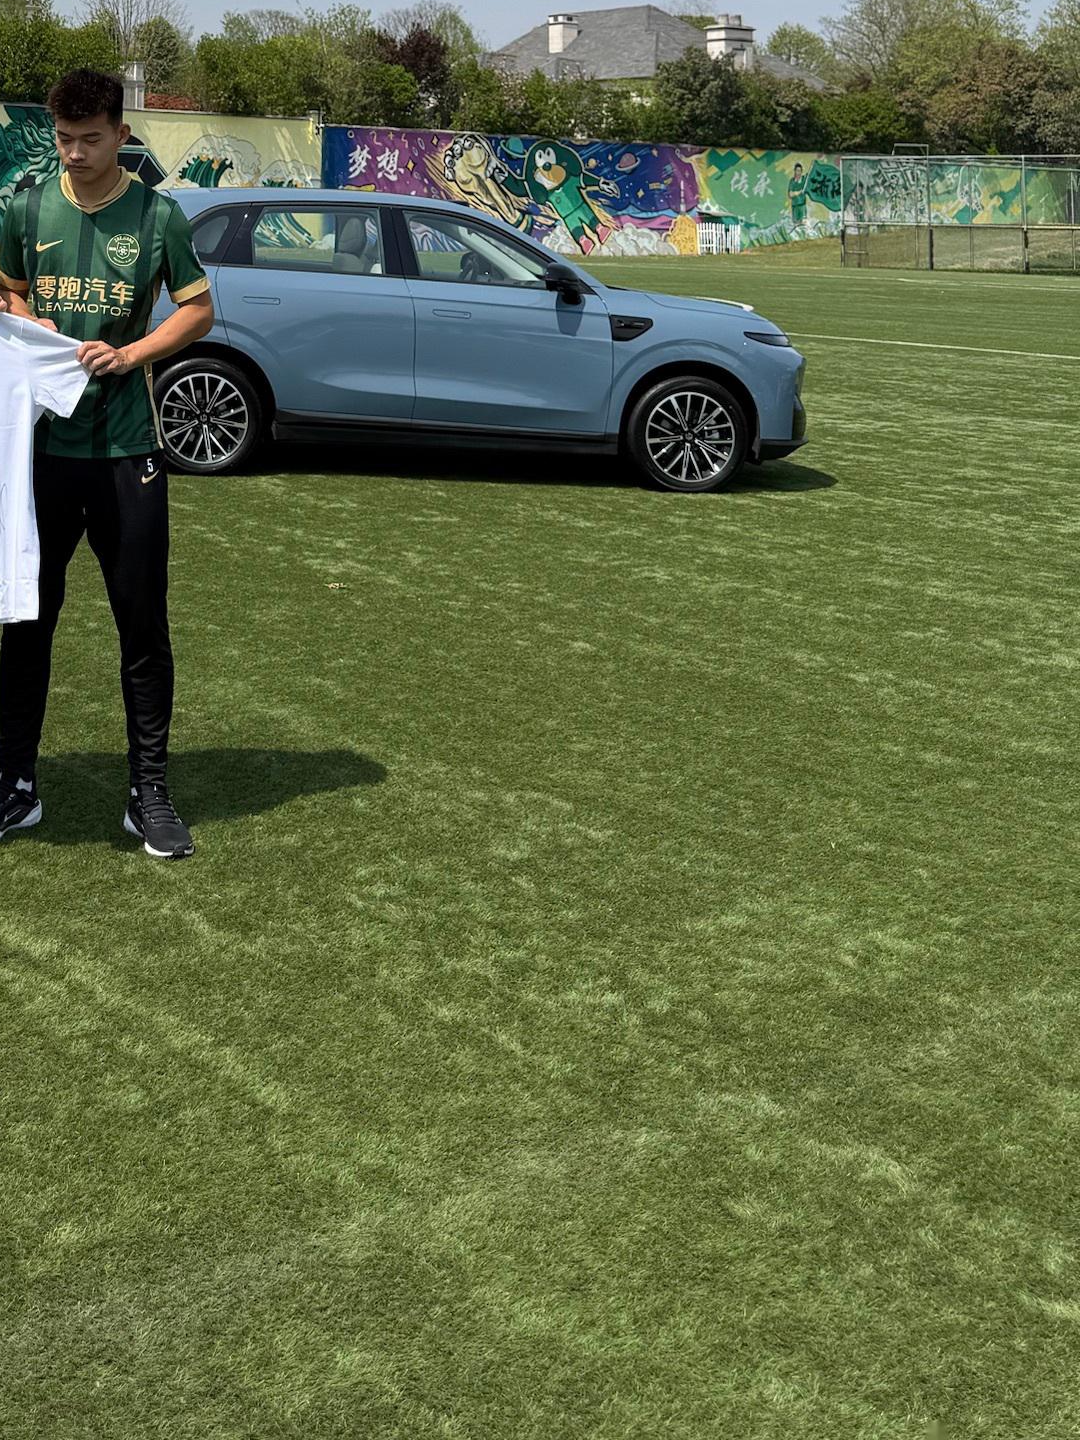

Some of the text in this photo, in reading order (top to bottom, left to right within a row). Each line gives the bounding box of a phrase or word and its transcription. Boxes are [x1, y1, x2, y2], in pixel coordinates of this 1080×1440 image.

[348, 144, 405, 181] 梦想
[730, 169, 774, 198] 传承
[36, 275, 135, 305] 零跑汽车
[37, 301, 132, 318] LEAPMOTOR
[146, 458, 154, 473] 5
